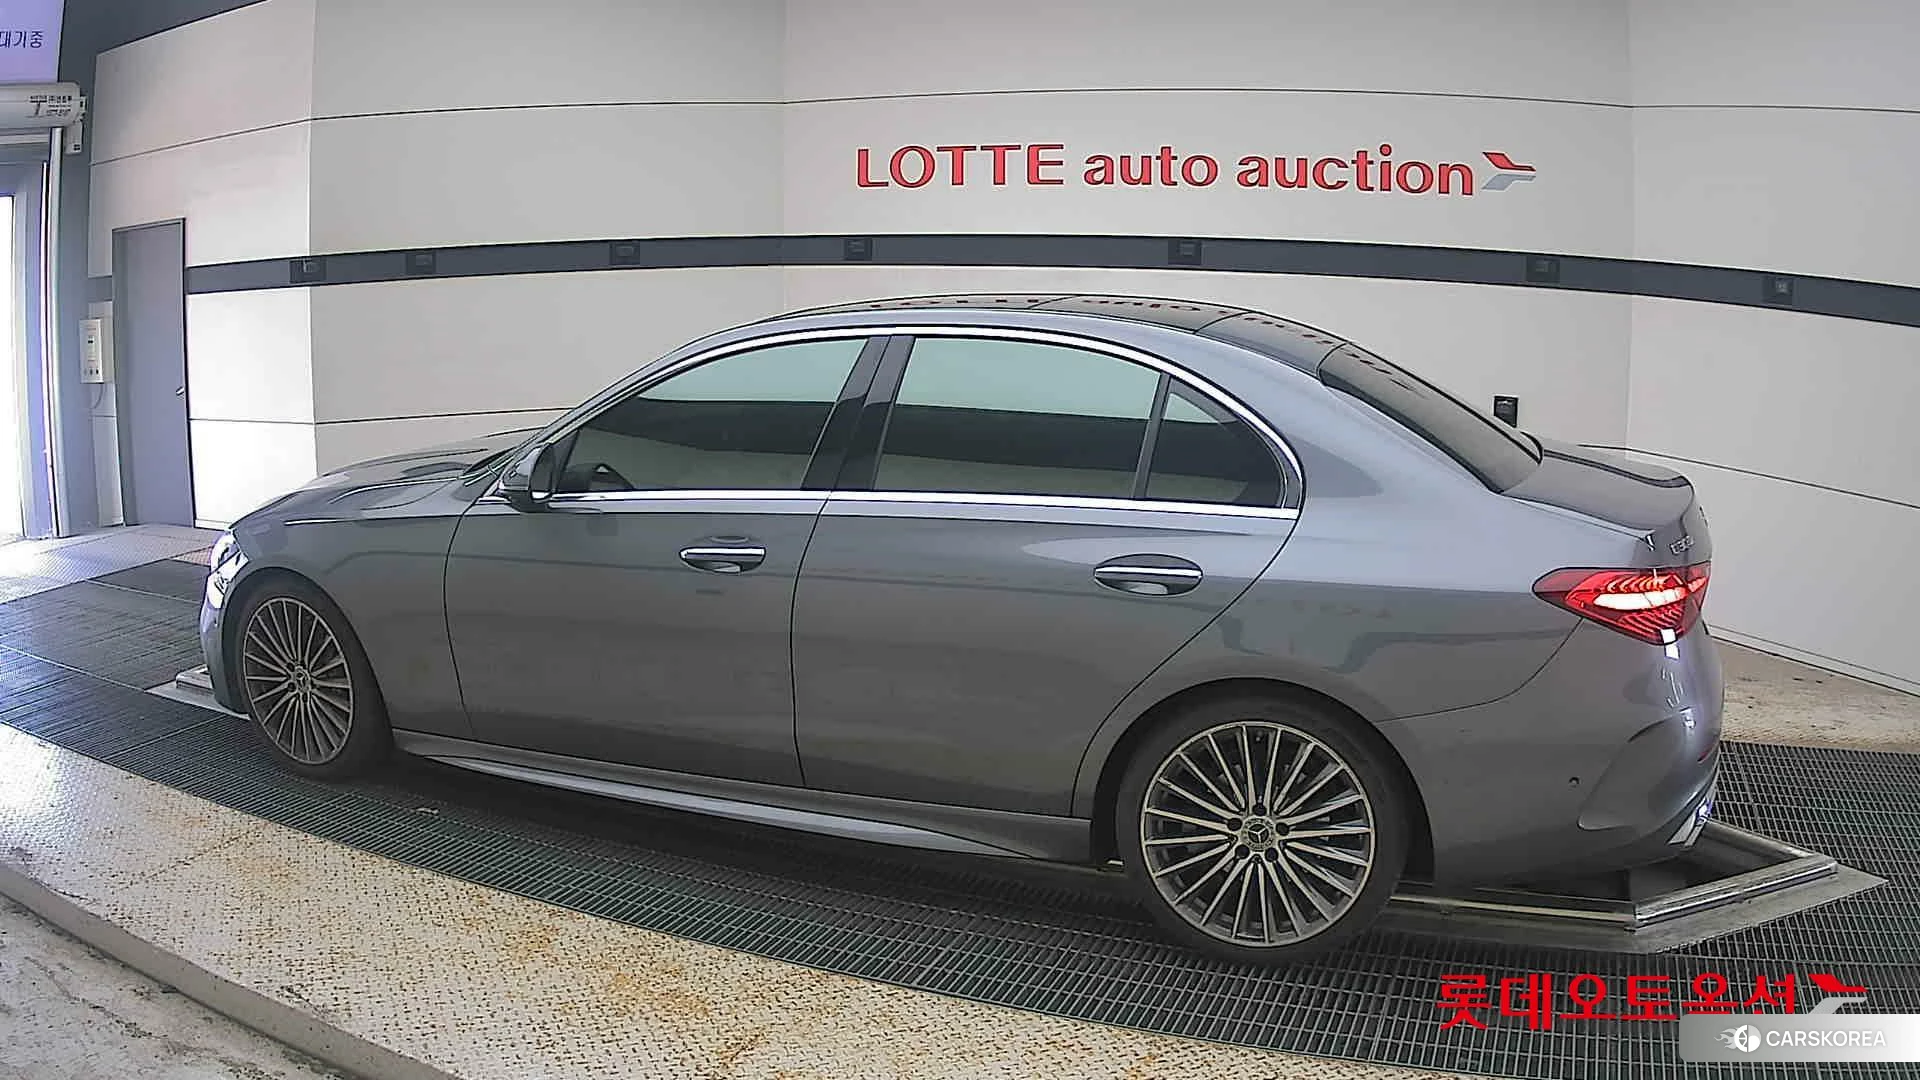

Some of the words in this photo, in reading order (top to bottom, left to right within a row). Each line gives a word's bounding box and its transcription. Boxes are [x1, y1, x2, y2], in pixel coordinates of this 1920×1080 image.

[857, 144, 1064, 189] LOTTE
[1083, 146, 1218, 187] auto
[1236, 143, 1473, 196] auction
